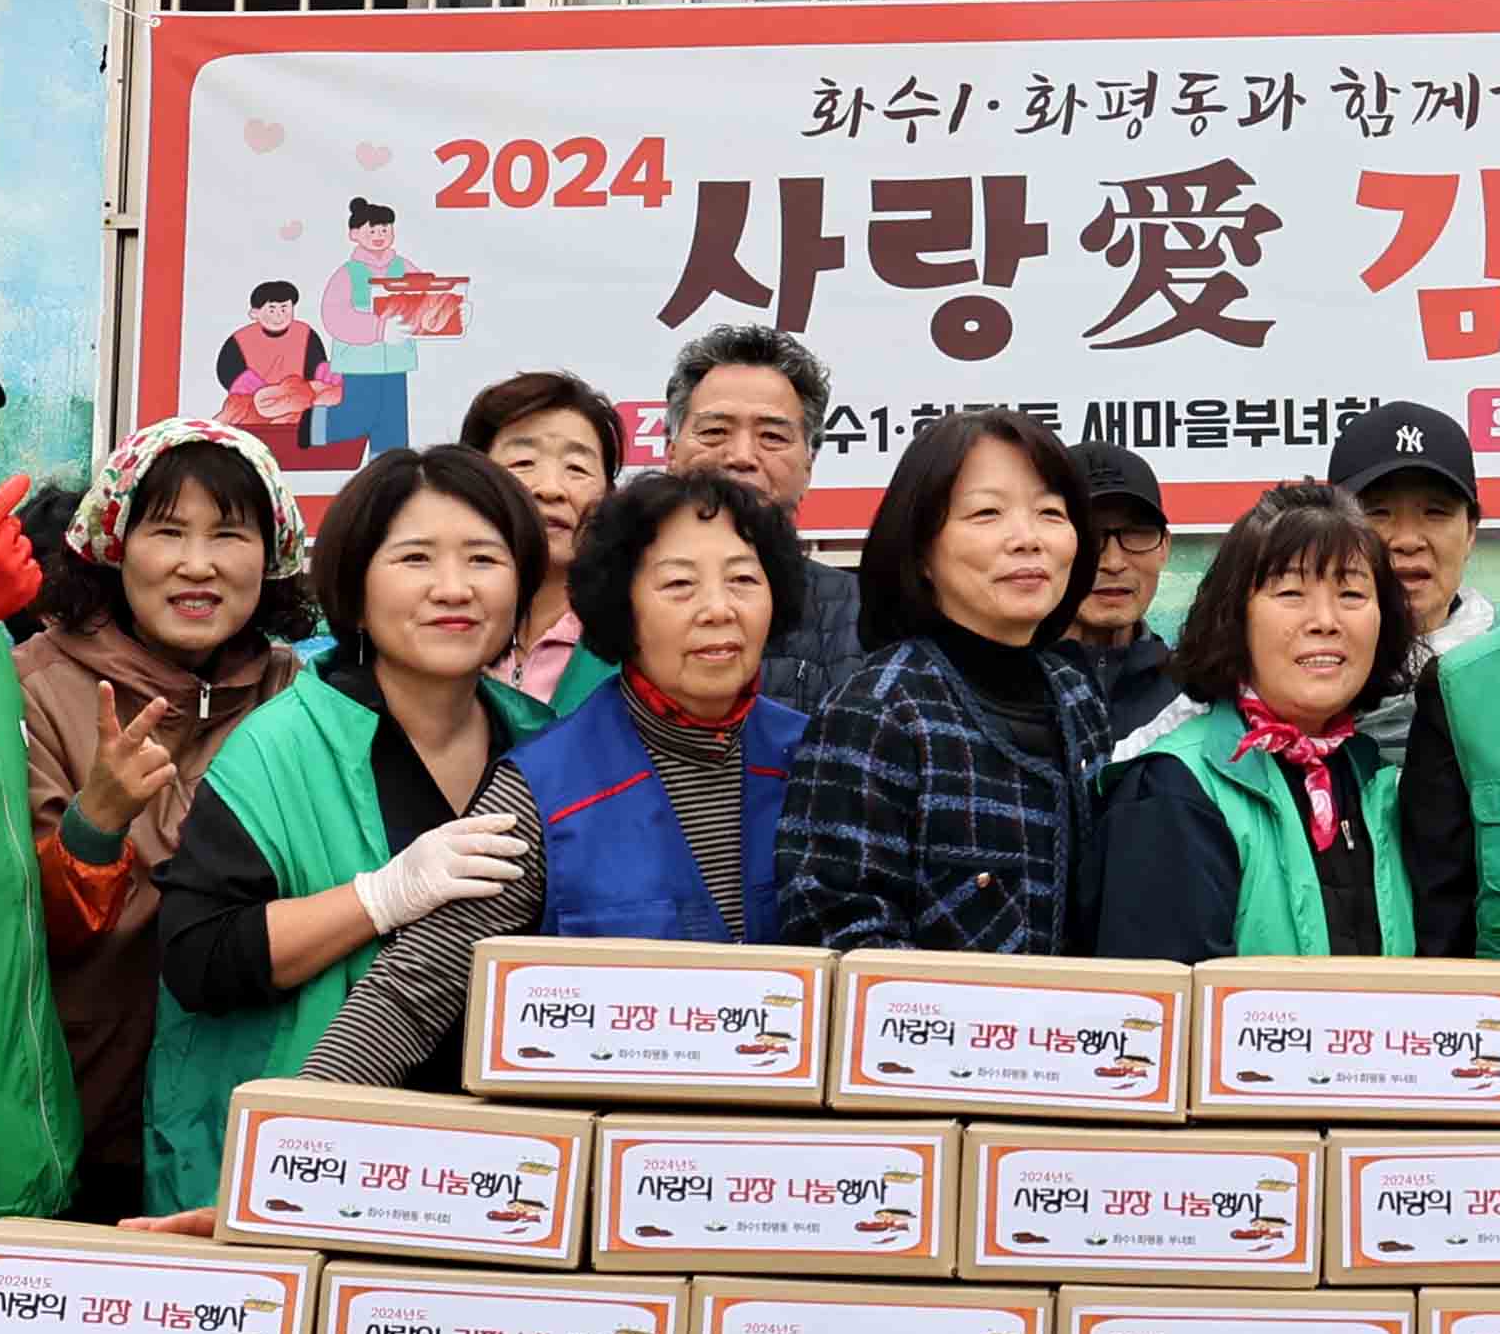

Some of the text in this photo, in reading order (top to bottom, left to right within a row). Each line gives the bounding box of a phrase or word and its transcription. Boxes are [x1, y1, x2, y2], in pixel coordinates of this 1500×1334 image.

[434, 136, 674, 210] 2024
[520, 1002, 596, 1030] 사랑의
[608, 1005, 659, 1032] 김장
[879, 1018, 957, 1048] 사랑의
[968, 1023, 1020, 1052] 김장
[1237, 1027, 1313, 1055] 사랑의
[1324, 1029, 1376, 1056] 김장
[269, 1154, 348, 1186] 사랑의
[360, 1162, 412, 1192] 김장
[1013, 1187, 1090, 1215] 사랑의
[1101, 1189, 1154, 1217] 김장
[1377, 1189, 1453, 1218] 사랑의
[80, 1297, 134, 1327] 김장
